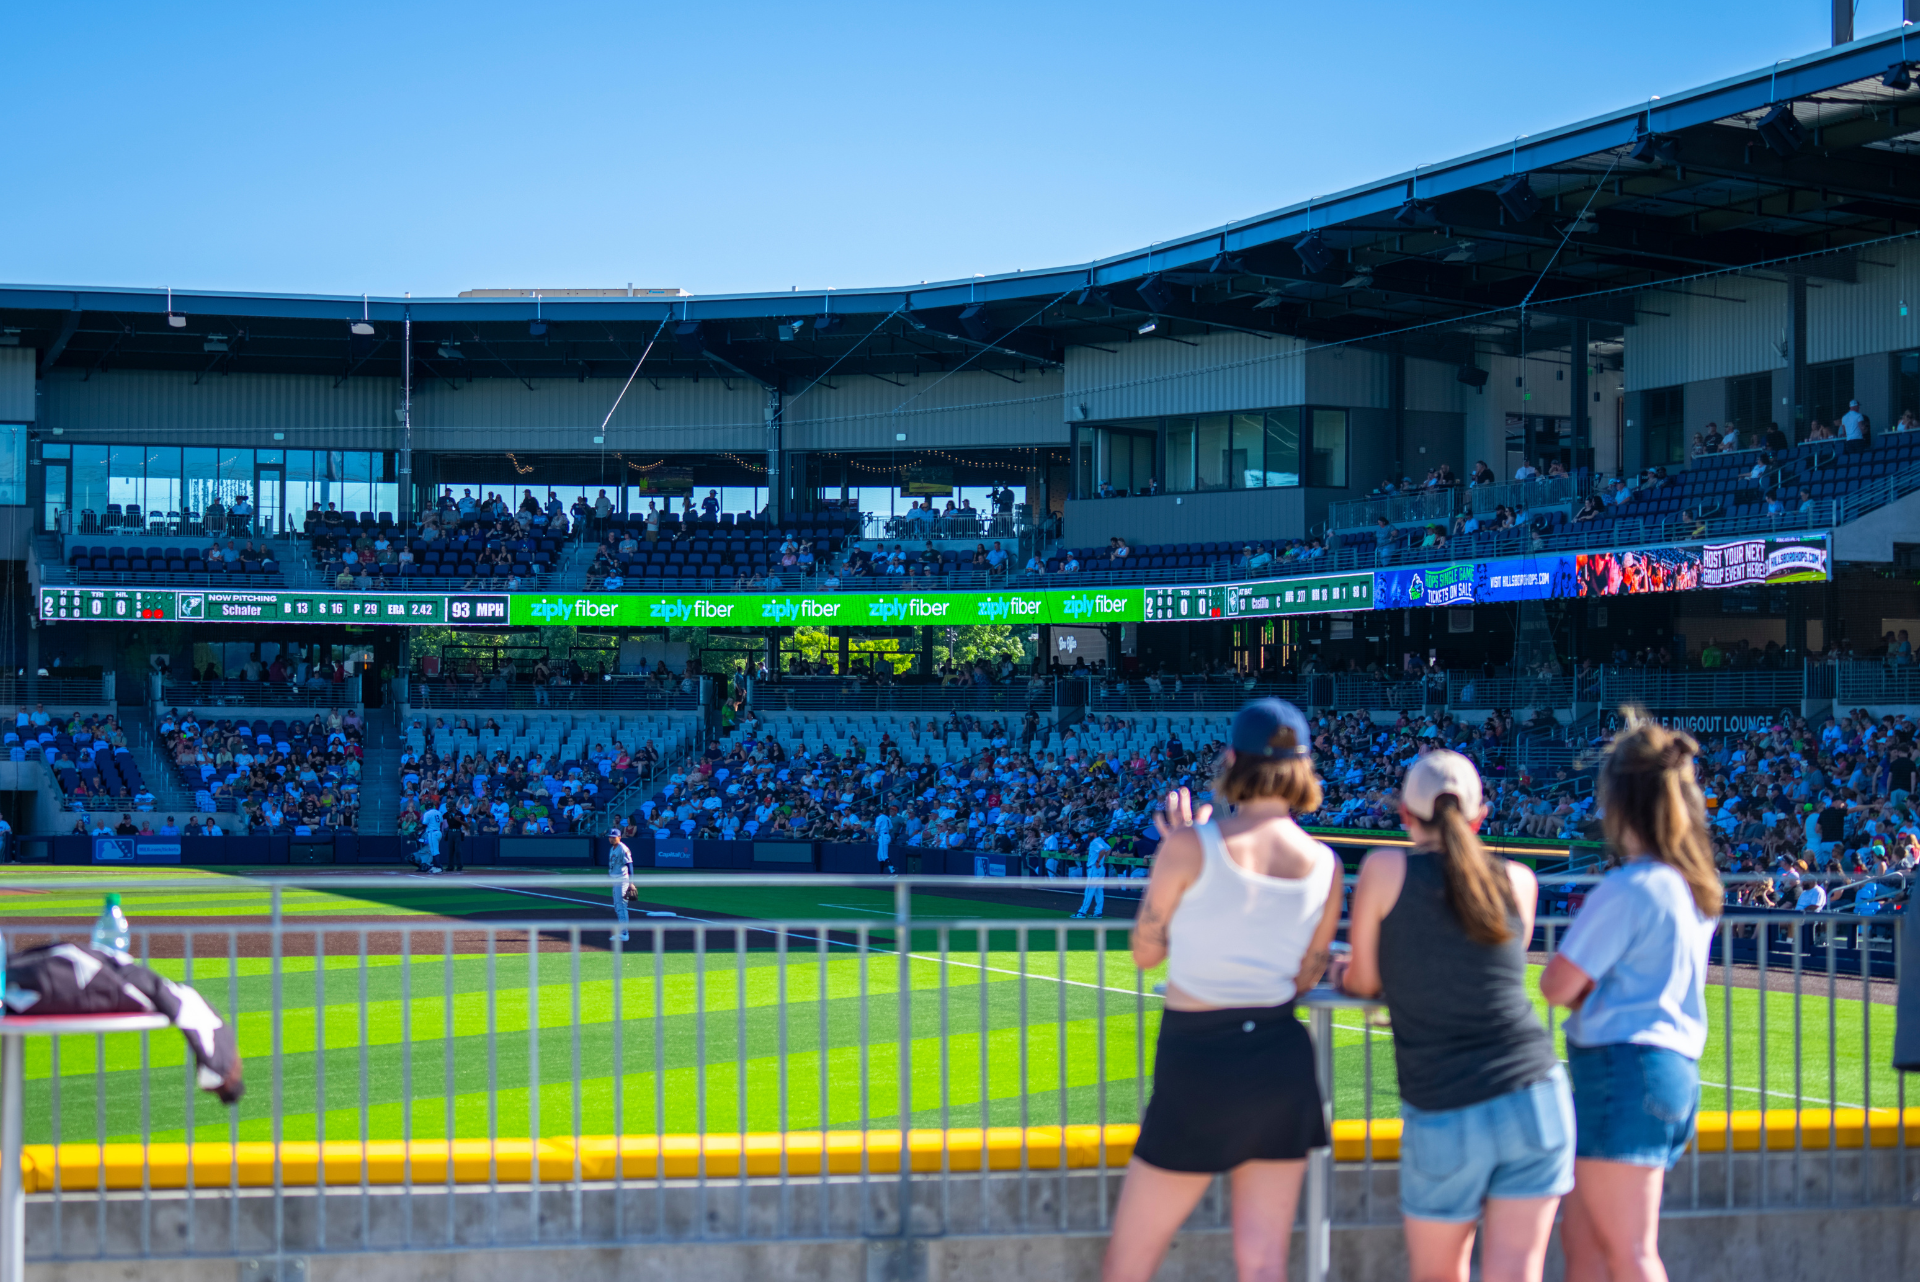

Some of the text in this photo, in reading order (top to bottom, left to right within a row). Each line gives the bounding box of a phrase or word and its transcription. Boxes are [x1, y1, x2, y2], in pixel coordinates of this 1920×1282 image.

[1704, 543, 1765, 568] HOST YOUR NEXT
[1440, 570, 1457, 587] SINGLE
[1459, 567, 1474, 582] GAME
[1490, 576, 1501, 588] VISIT
[1704, 567, 1723, 584] GROUP
[1725, 564, 1745, 582] EVENT
[136, 592, 142, 600] B
[1342, 587, 1346, 599] 1
[1362, 585, 1367, 598] 0
[1428, 582, 1472, 604] TICKETS ON SALE
[44, 596, 54, 611] 2
[60, 597, 80, 606] 0 0
[92, 600, 102, 615] 0
[116, 600, 126, 615] 0
[284, 602, 432, 615] B 13 S 16 P 29 ERA 2.42
[978, 597, 1041, 621] ziply fiber
[1063, 594, 1127, 618] ziply fiber
[1147, 597, 1153, 613] 2
[1158, 596, 1172, 606] 0 0
[1180, 599, 1188, 615] 0
[1199, 598, 1206, 614] 0
[60, 608, 80, 617] 0 0
[222, 604, 262, 616] Schafer
[452, 602, 504, 618] 93 MPH
[531, 598, 618, 621] ziply fiber
[650, 599, 734, 622] ziply fiber
[762, 599, 840, 622] ziply fiber
[869, 598, 949, 621] ziply fiber
[1158, 608, 1172, 618] 0 0
[1673, 716, 1721, 732] DUGOUT
[1724, 716, 1773, 732] LOUNGE
